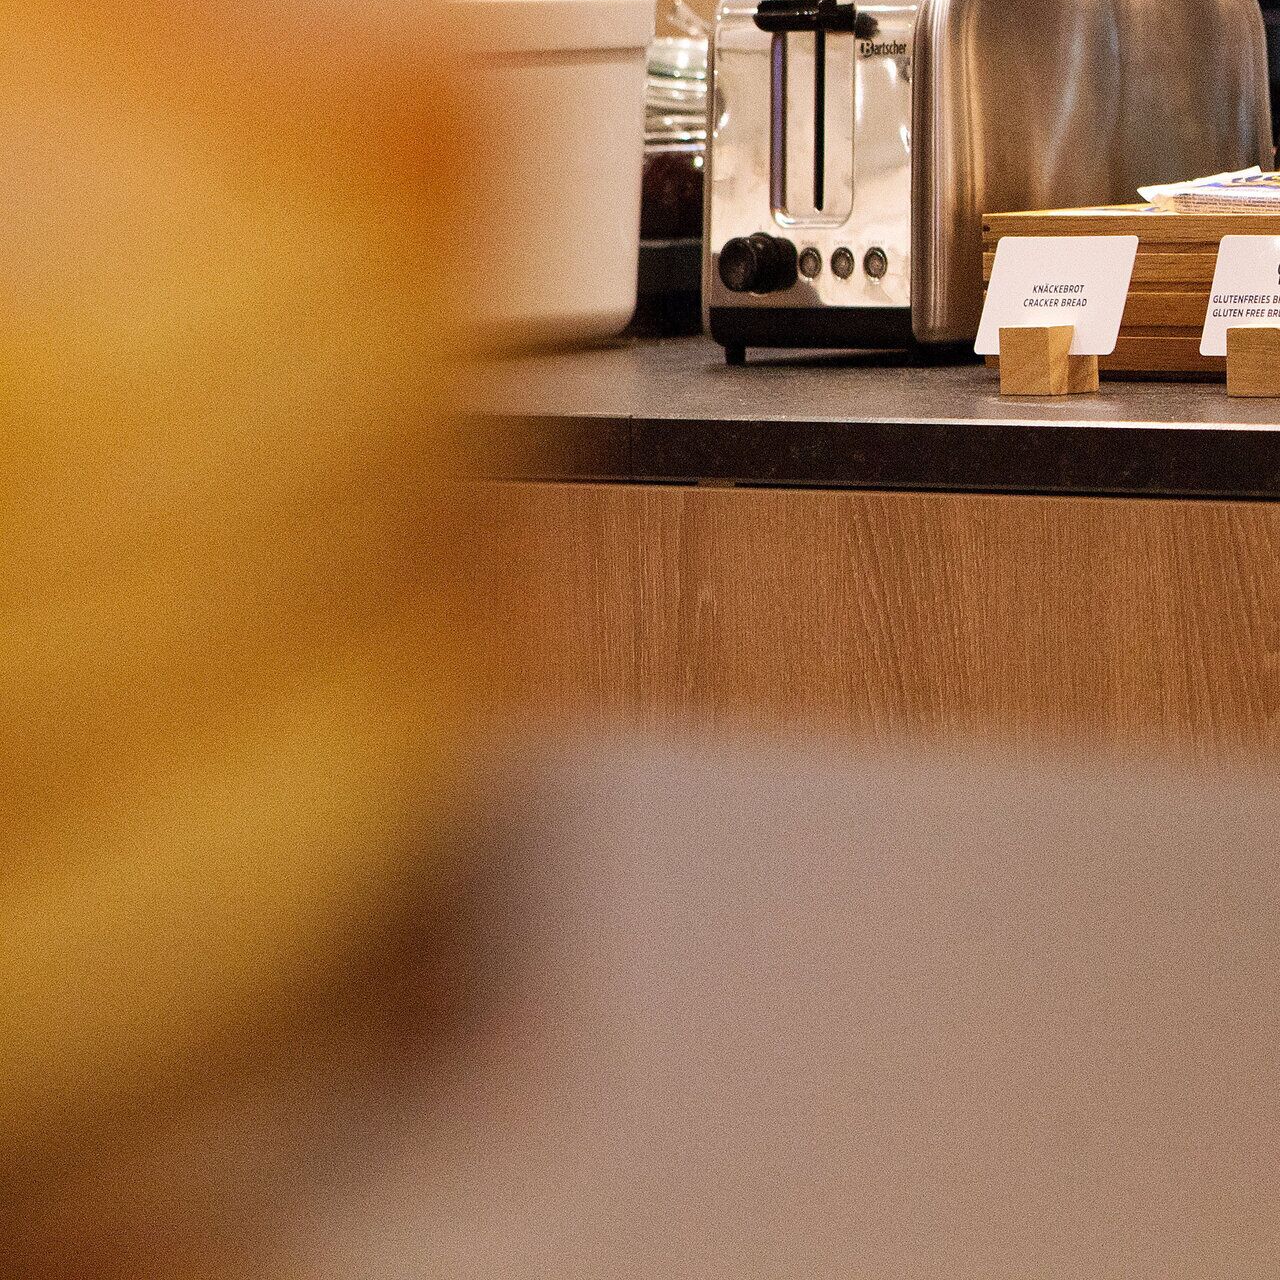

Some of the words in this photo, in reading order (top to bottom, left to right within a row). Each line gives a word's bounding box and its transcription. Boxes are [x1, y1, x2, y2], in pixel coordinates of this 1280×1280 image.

[860, 40, 906, 58] Bartscher
[1032, 283, 1084, 293] KNÄCKEBROT
[1023, 298, 1059, 307] CRACKER
[1060, 298, 1087, 307] BREAD
[1212, 294, 1270, 304] GLUTENFREIES
[1212, 308, 1243, 318] GLUTEN
[1245, 308, 1266, 318] FREE
